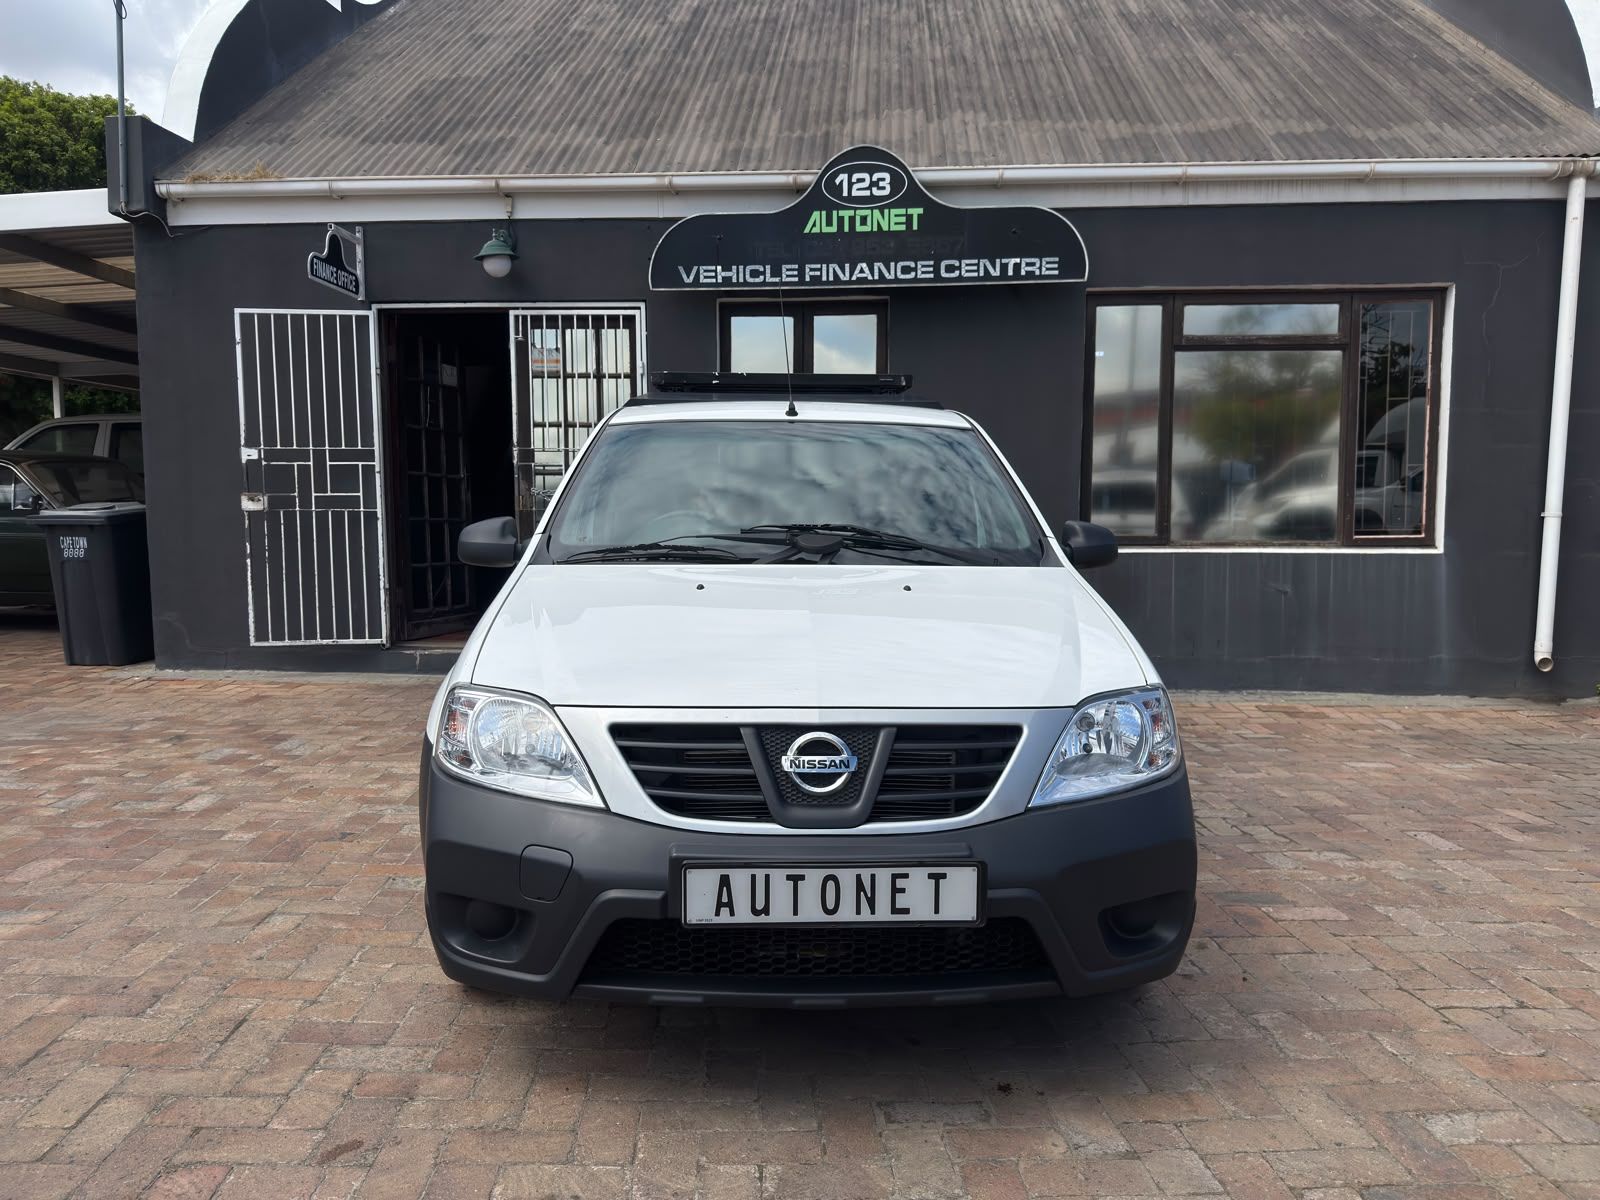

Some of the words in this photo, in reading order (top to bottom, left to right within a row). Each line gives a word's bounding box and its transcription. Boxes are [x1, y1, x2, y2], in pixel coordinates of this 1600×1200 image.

[833, 172, 891, 198] 123
[803, 207, 924, 234] AUTONET
[313, 257, 337, 285] FINANCE
[337, 269, 356, 292] OFFICE
[678, 263, 799, 284] VEHICLE
[804, 260, 935, 282] FINANCE
[940, 257, 1060, 280] CENTRE
[60, 536, 73, 549] CAPE
[73, 536, 88, 549] TOWN
[789, 759, 850, 770] NISSAN
[714, 872, 948, 917] AUTONET
